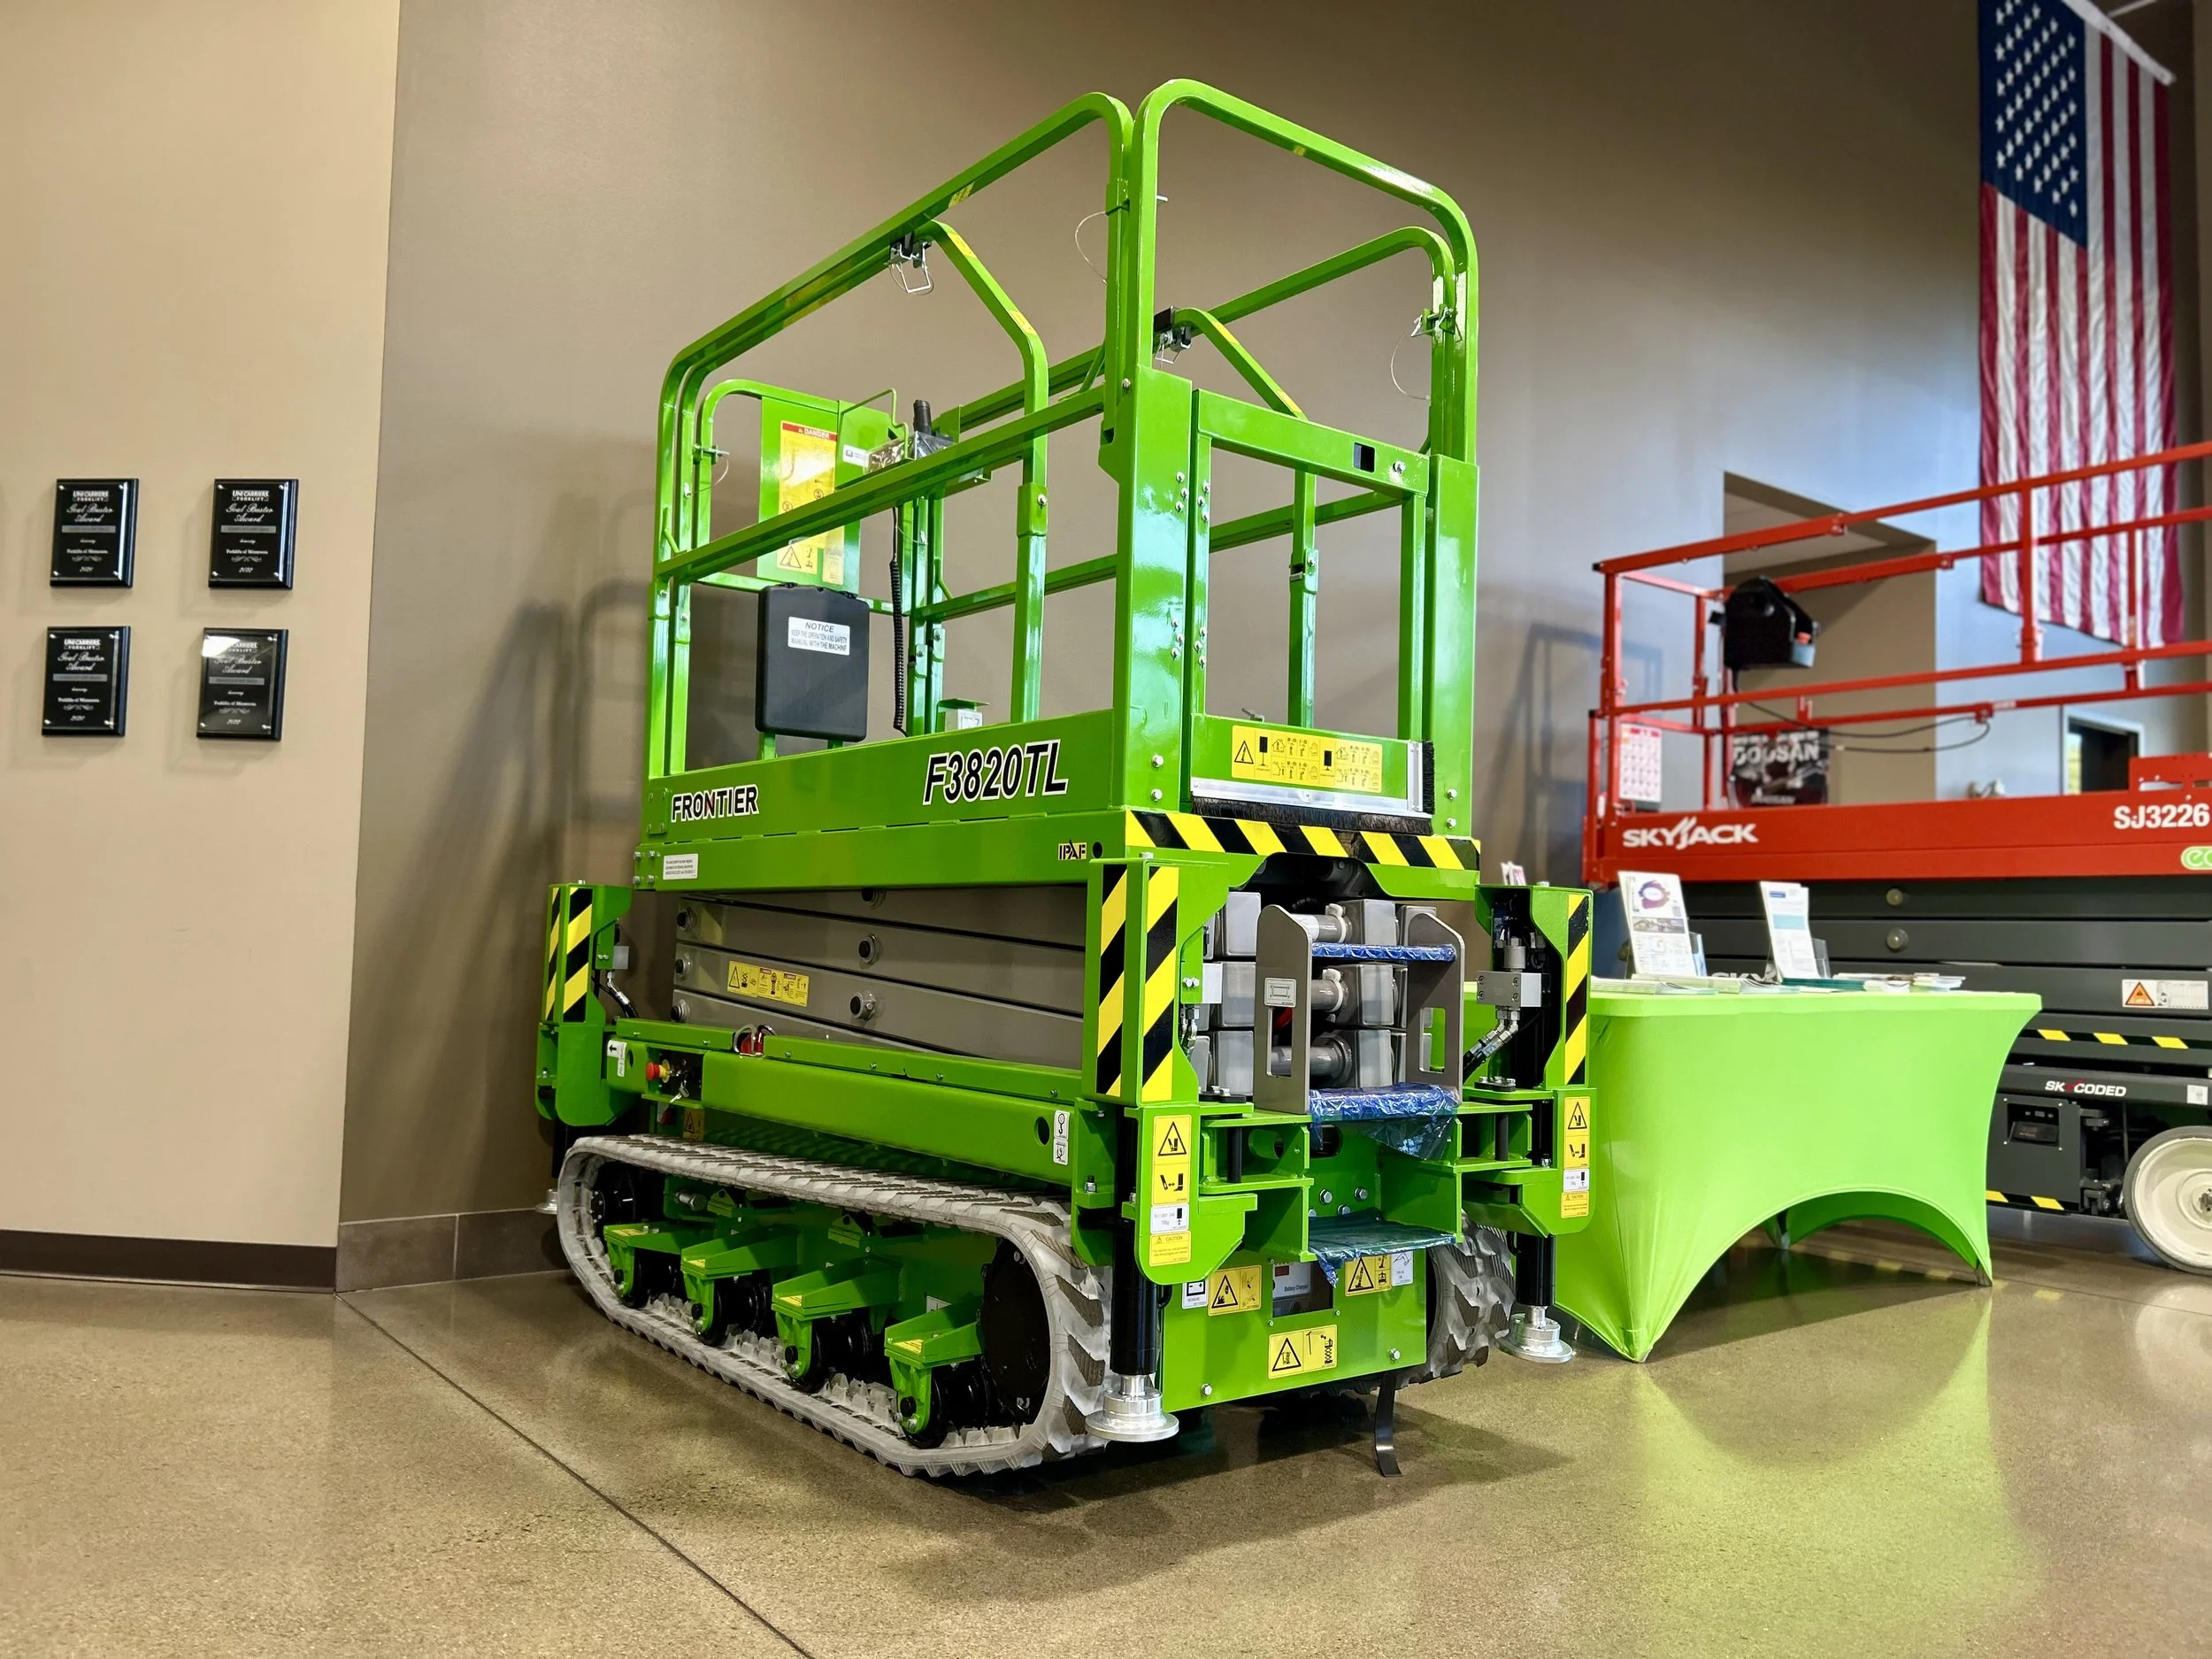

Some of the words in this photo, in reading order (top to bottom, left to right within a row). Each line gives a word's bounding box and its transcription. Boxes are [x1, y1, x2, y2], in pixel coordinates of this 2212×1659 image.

[804, 427, 830, 440] DANGER
[74, 512, 104, 522] Award
[234, 512, 265, 522] Award
[805, 622, 834, 634] NOTICE
[791, 637, 809, 647] MANUAL
[828, 642, 847, 652] MACHINE
[807, 632, 826, 641] OPERATION
[834, 635, 847, 644] SAFETY
[65, 661, 96, 671] Award
[222, 664, 252, 674] Award
[923, 739, 1069, 805] F3820TL
[671, 784, 759, 823] FRONTIER
[2113, 803, 2210, 829] SJ3226
[1622, 816, 1759, 849] SKYJACK
[1058, 839, 1087, 861] IPAF
